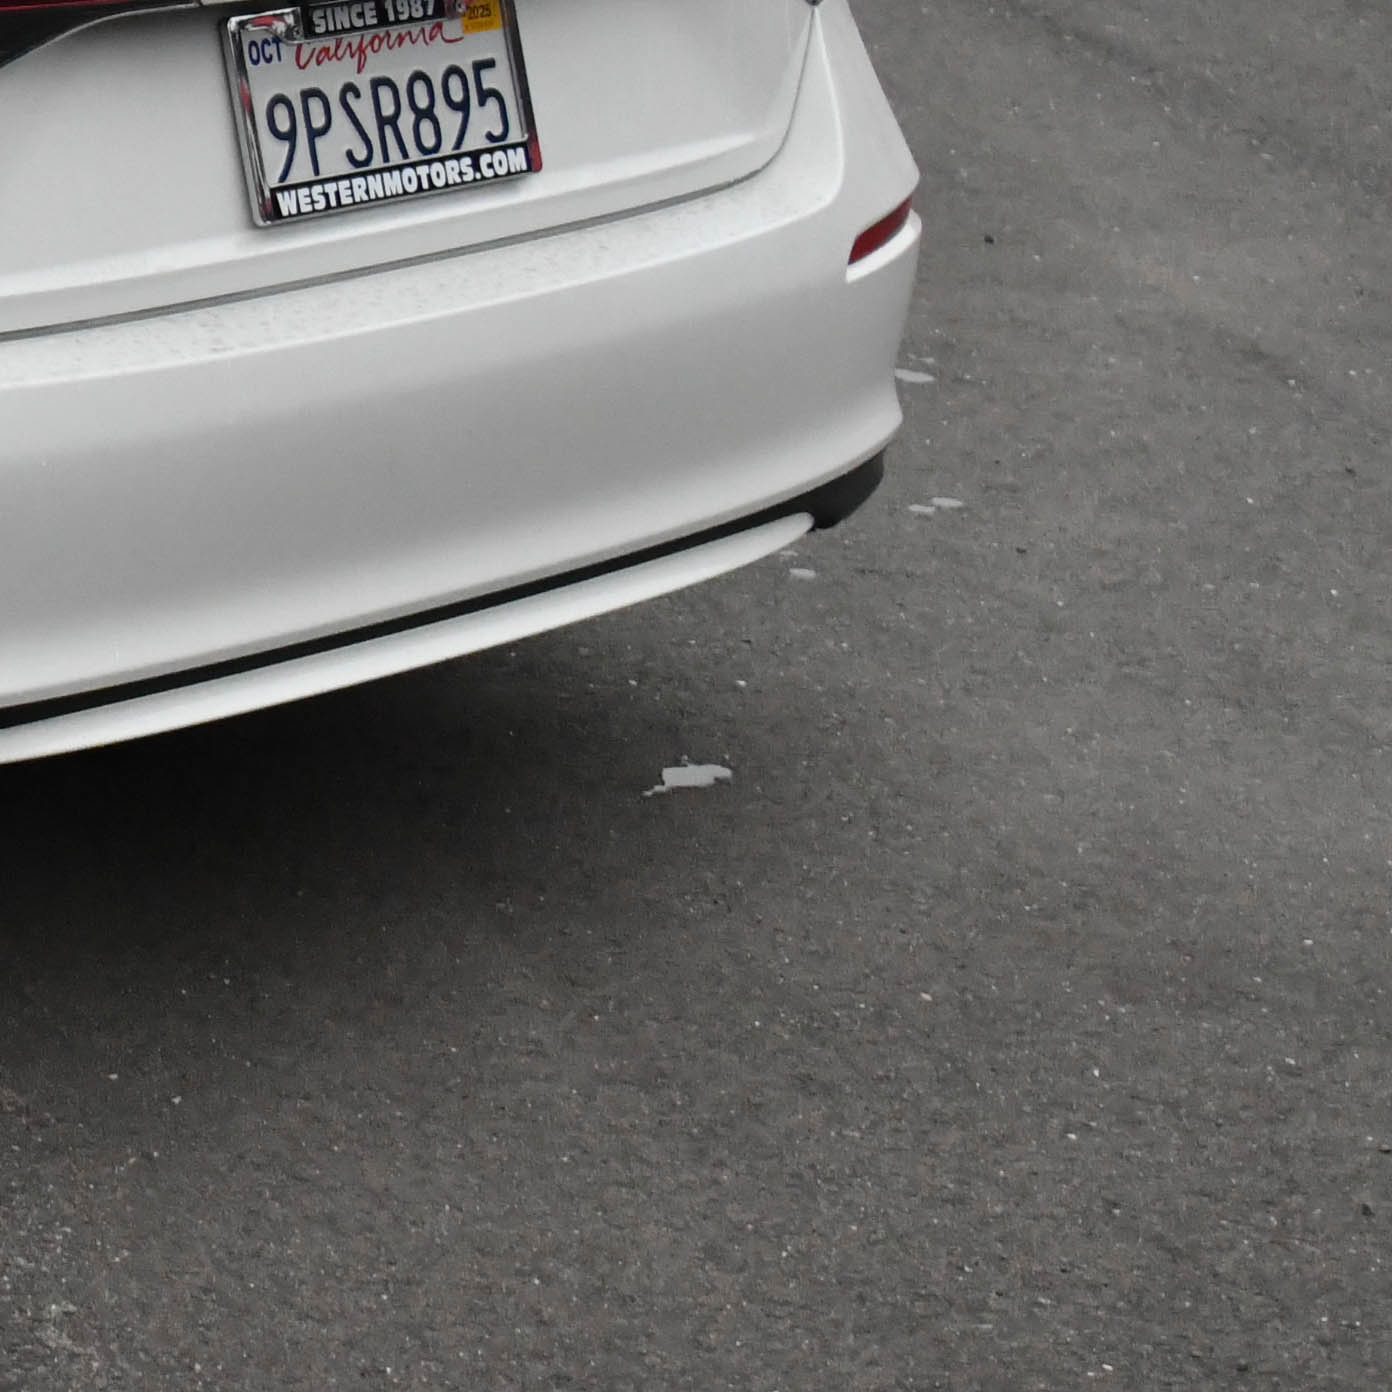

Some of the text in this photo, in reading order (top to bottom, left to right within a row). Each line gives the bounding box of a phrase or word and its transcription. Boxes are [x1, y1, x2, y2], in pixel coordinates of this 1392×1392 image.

[312, 0, 378, 34] SINCE
[248, 35, 282, 66] OCT
[266, 58, 510, 184] 9PSR895
[276, 148, 528, 217] WESTERNMOTORS.COM
